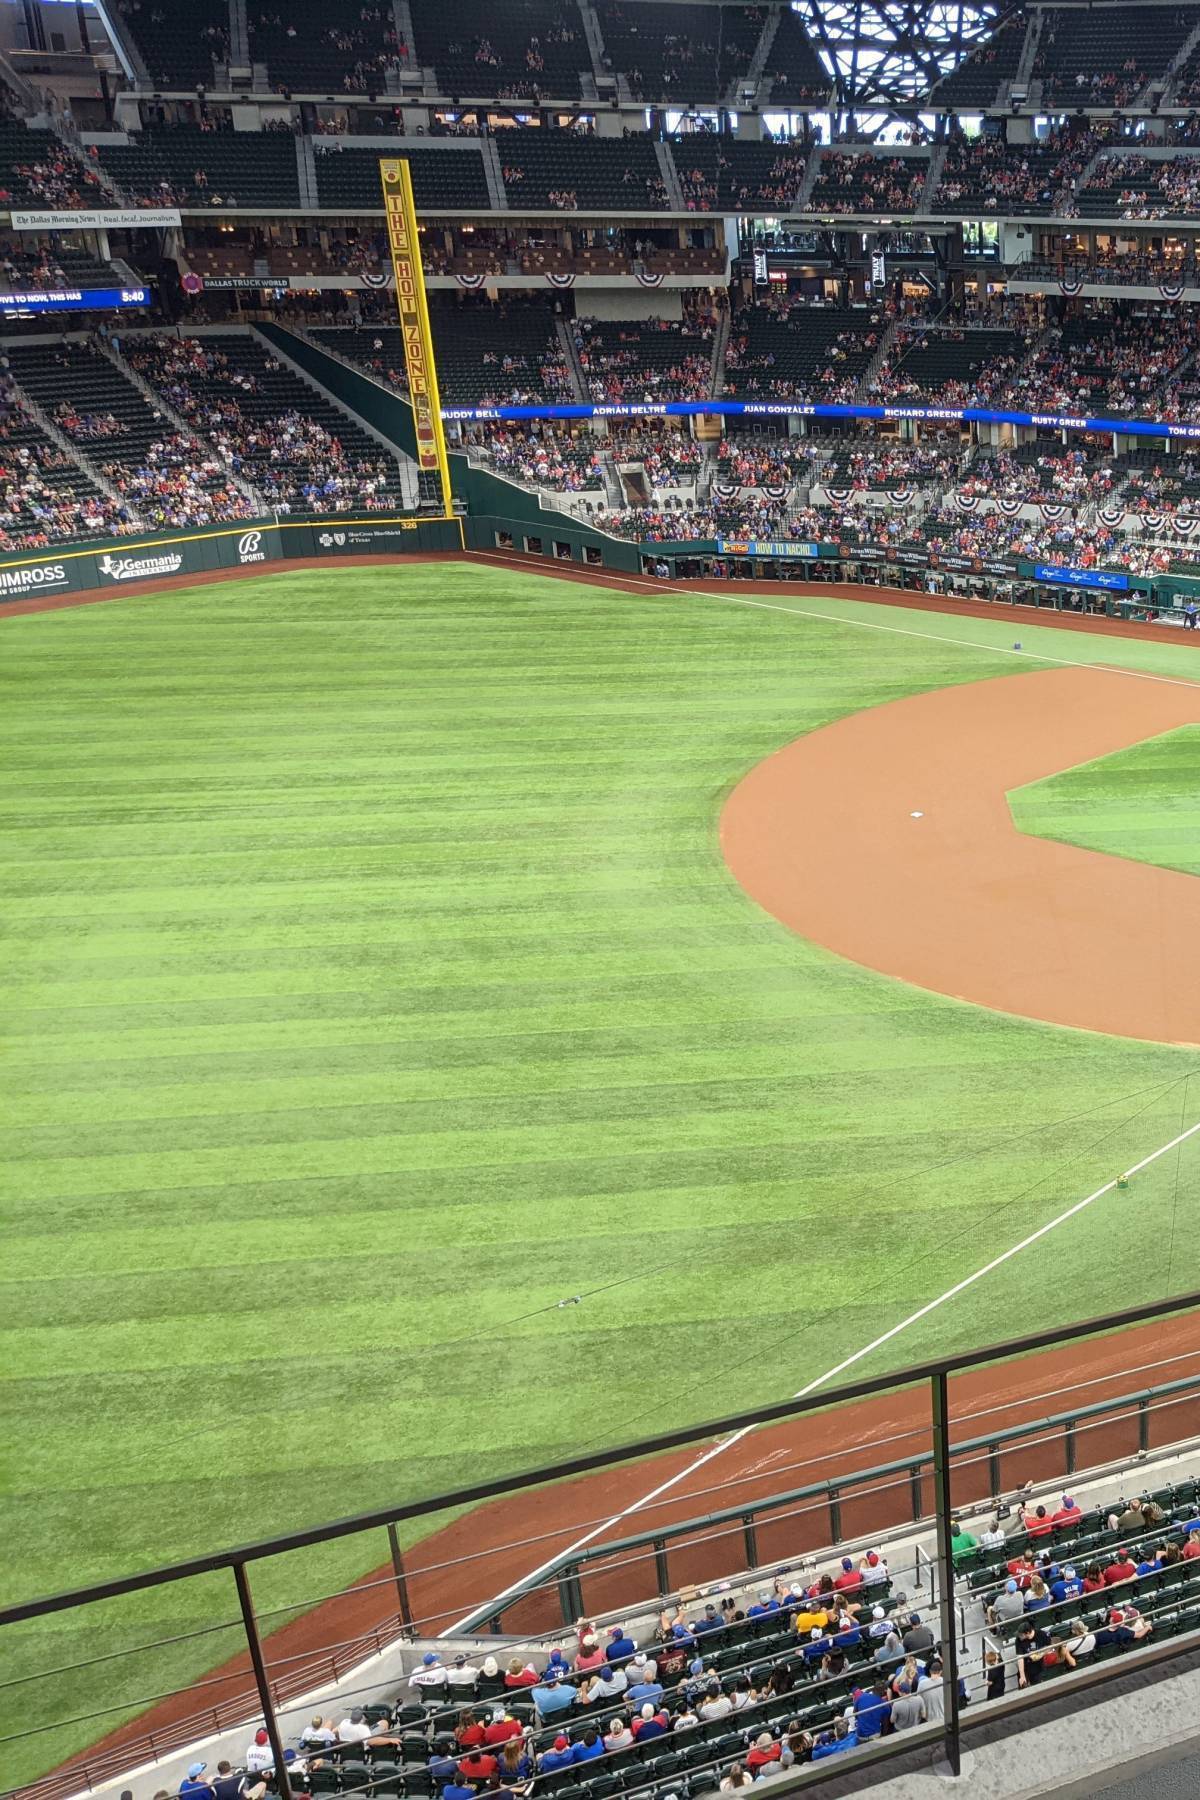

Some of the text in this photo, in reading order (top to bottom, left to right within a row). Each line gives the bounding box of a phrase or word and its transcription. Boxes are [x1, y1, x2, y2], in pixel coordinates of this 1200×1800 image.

[29, 215, 50, 224] Dallas
[51, 215, 78, 225] Morning
[78, 215, 96, 225] News
[389, 196, 406, 247] THE
[872, 256, 880, 280] TRULY
[232, 279, 261, 287] TRUCK
[398, 262, 414, 312] HOT
[15, 295, 26, 303] TO
[50, 293, 66, 301] THIS
[66, 292, 82, 301] HAS
[406, 327, 425, 392] ZONE
[440, 409, 501, 419] BUDDY BELL
[743, 405, 765, 413] JUAN
[884, 408, 963, 419] RICHARD GREENE
[1031, 416, 1087, 428] RUSTY GREER
[1168, 427, 1187, 436] TOM
[755, 543, 772, 554] HOW
[775, 543, 784, 554] TO
[125, 553, 182, 570] Germania
[240, 552, 265, 563] SPORTS
[9, 586, 30, 594] GROUP
